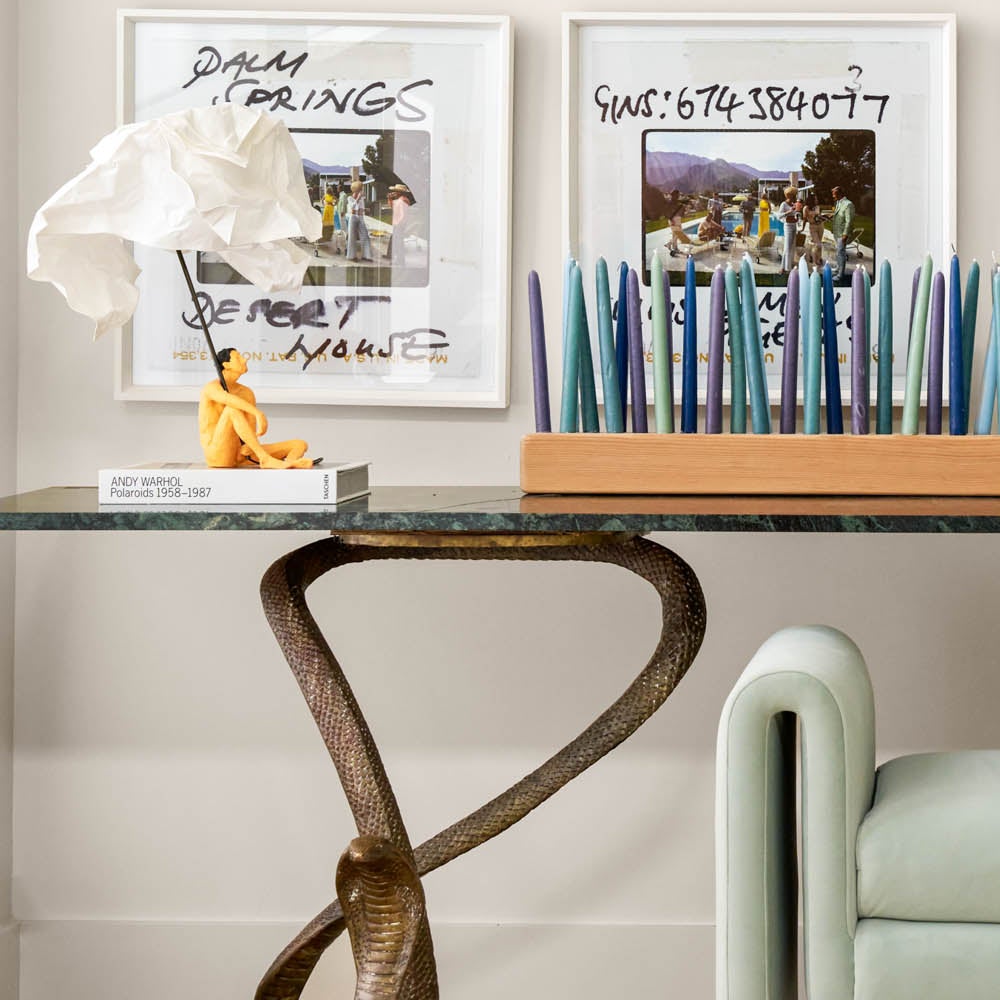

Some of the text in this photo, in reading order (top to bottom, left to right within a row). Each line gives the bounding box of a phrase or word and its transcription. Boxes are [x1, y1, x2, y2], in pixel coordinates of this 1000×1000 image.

[110, 476, 183, 486] ANDY WARHOL
[110, 488, 154, 498] Polaroids
